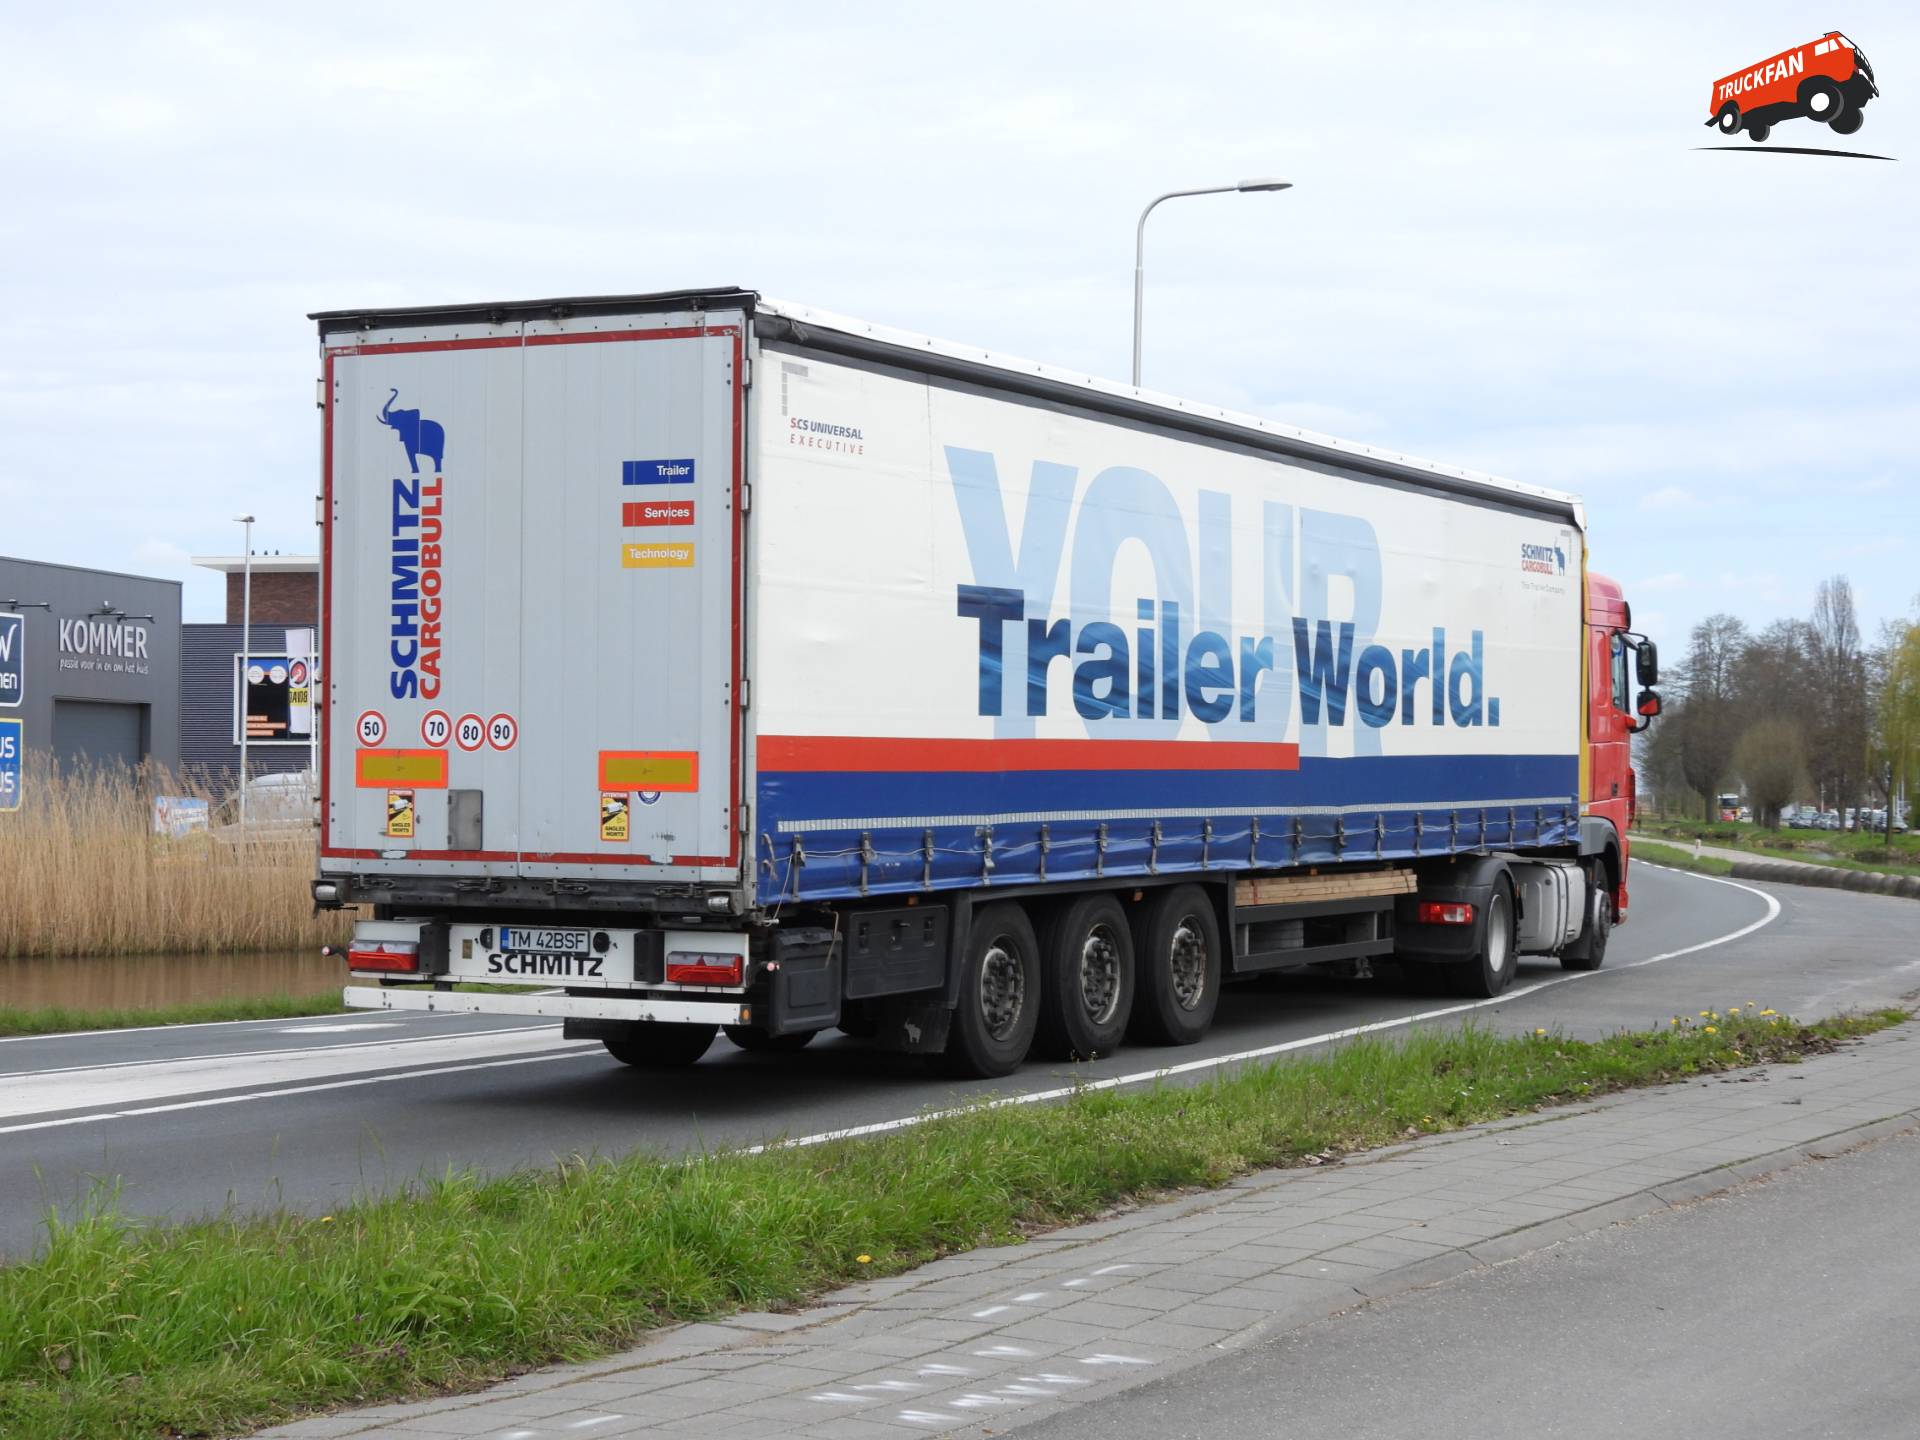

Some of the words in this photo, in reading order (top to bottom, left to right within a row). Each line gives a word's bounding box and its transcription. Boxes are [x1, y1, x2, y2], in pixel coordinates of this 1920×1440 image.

[790, 417, 809, 431] SCS
[810, 420, 863, 440] UNIVERSAL
[790, 433, 863, 455] EXECUTIVE
[656, 465, 690, 476] Trailer
[644, 507, 690, 518] Services
[629, 548, 689, 560] Technology
[1521, 543, 1553, 562] SCHMITZ
[1521, 559, 1553, 575] CARGOBULL
[390, 478, 419, 699] SCHMITZ
[419, 477, 443, 700] CARGOBULL
[944, 445, 1384, 757] YOUR
[59, 618, 148, 660] KOMMER
[80, 660, 95, 671] voor
[96, 658, 103, 670] in
[957, 584, 1274, 723] Trailer
[1292, 616, 1500, 728] World.
[363, 721, 380, 737] 50
[429, 721, 445, 737] 70
[462, 724, 479, 741] 80
[494, 724, 510, 740] 90
[510, 930, 531, 948] TM
[536, 931, 586, 950] 42BSF
[488, 953, 603, 977] SCHMITZ
